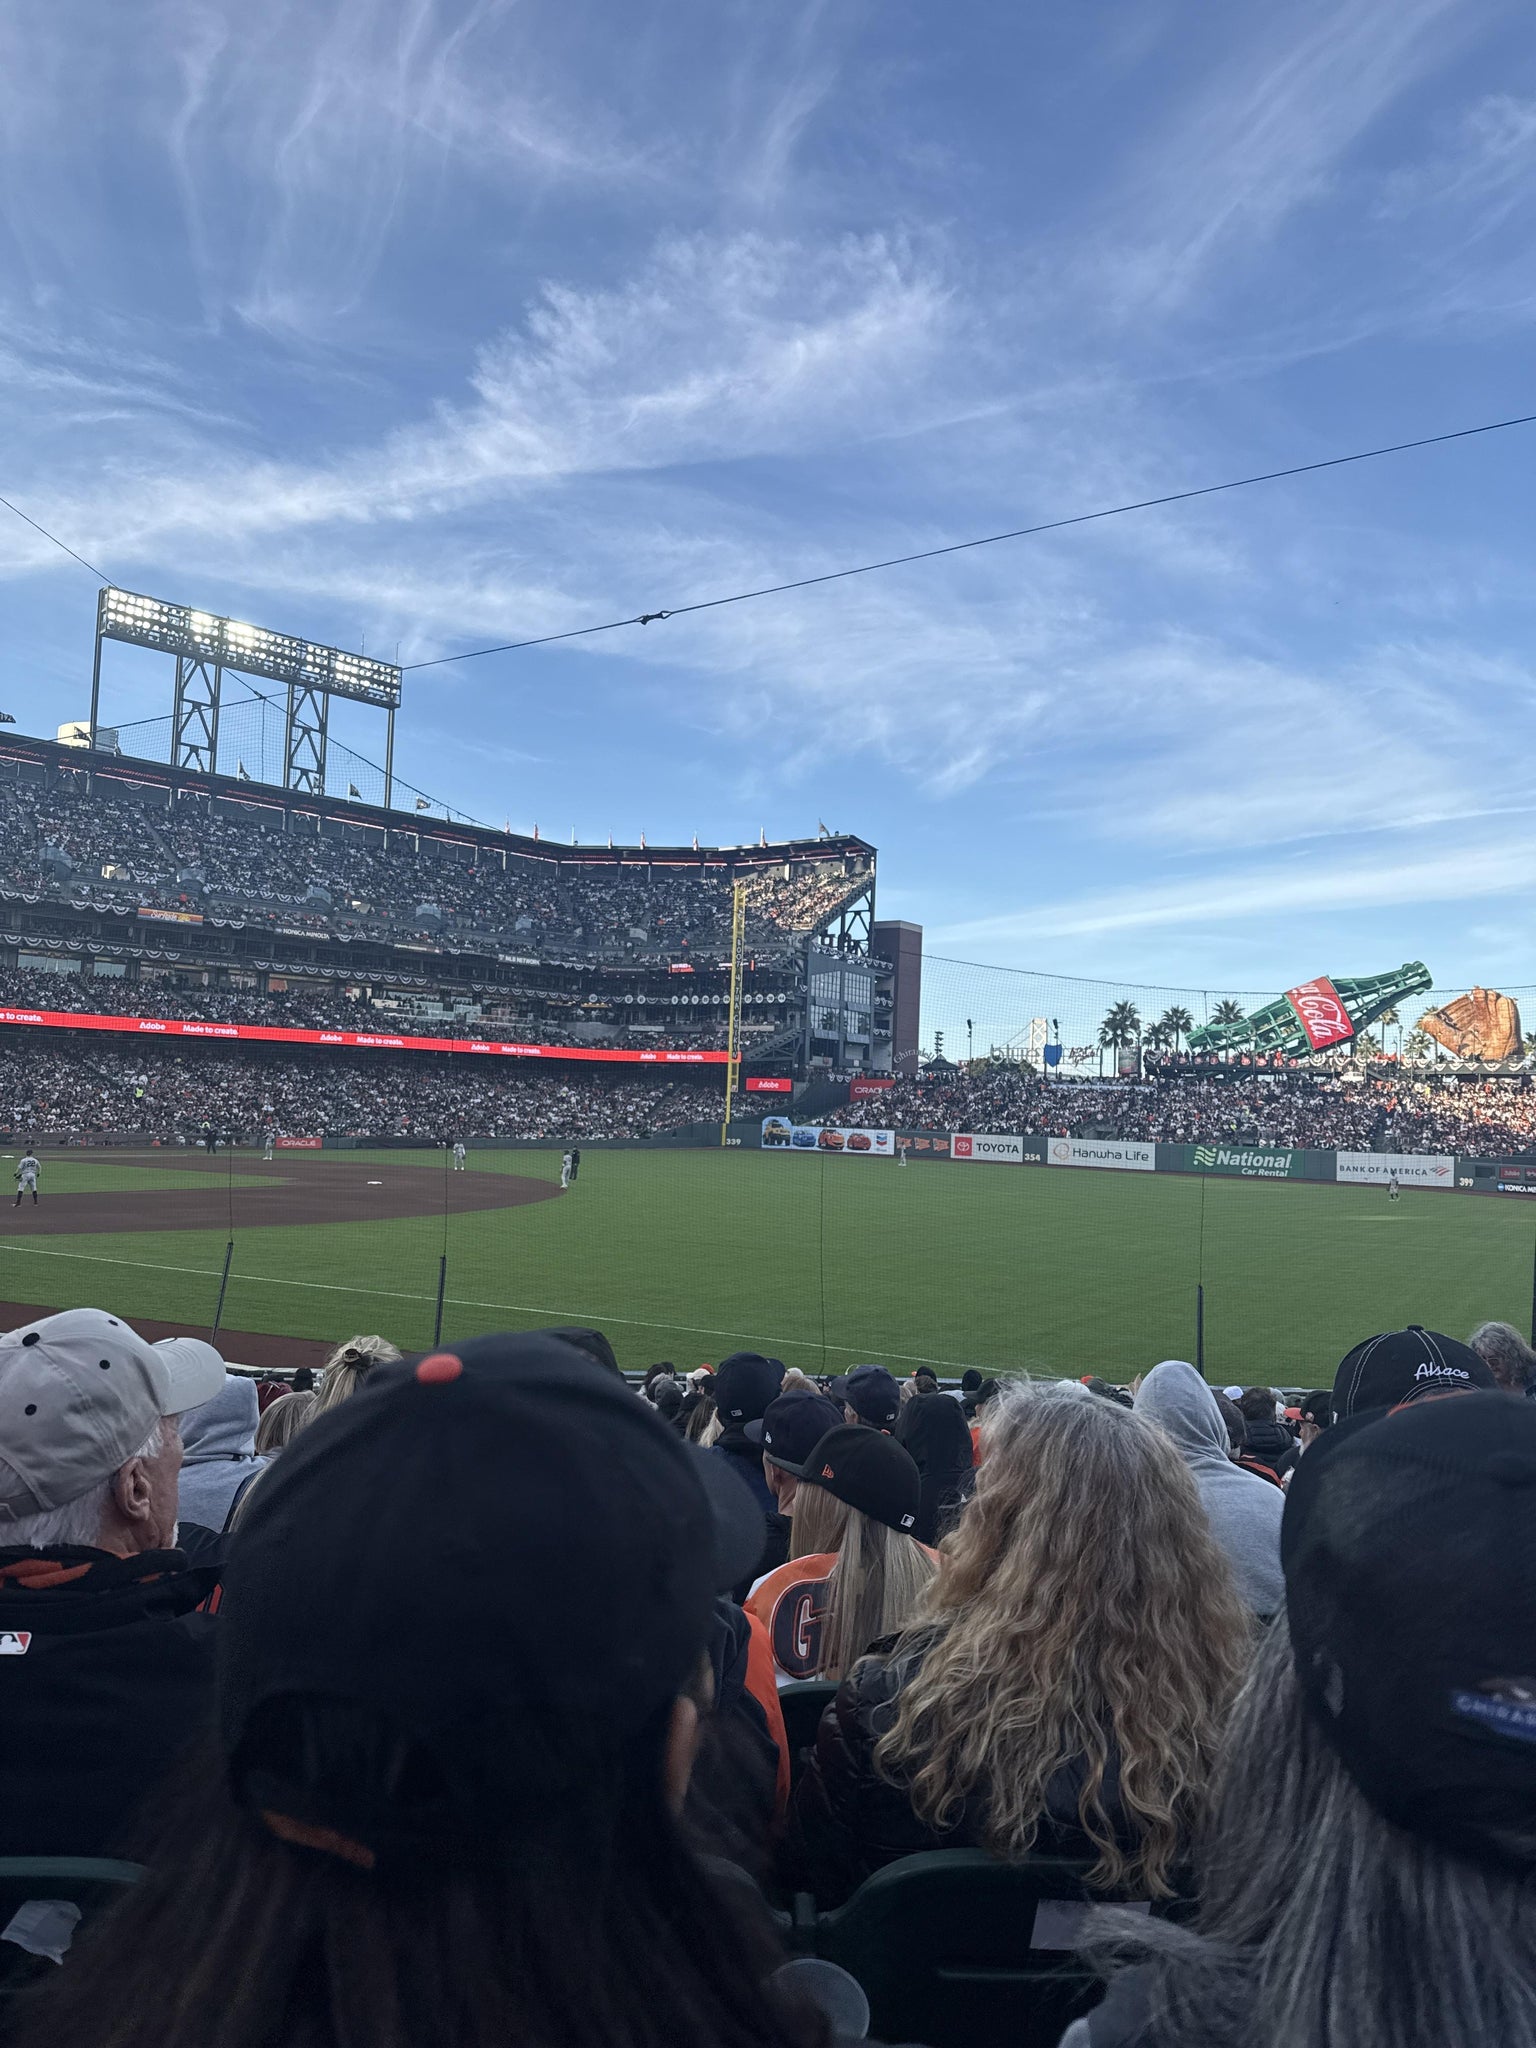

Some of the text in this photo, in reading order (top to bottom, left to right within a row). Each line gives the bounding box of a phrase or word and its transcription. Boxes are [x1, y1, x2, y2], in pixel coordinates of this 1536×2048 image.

[6, 1012, 15, 1020] to
[16, 1013, 44, 1022] create.
[1298, 995, 1349, 1039] Cola
[139, 1022, 166, 1030] Adobe
[183, 1025, 204, 1033] Made
[205, 1026, 213, 1034] to
[320, 1034, 343, 1042] Adobe
[356, 1036, 374, 1044] Made
[382, 1038, 404, 1046] create.
[523, 1047, 541, 1055] create.
[990, 1044, 1040, 1064] blue
[758, 1081, 779, 1089] Adobe
[976, 1142, 1019, 1154] TOYOTA
[1024, 1153, 1041, 1162] 354
[1072, 1148, 1149, 1162] Hanwha Life
[1216, 1150, 1292, 1168] National
[1258, 1168, 1288, 1177] Rental
[1339, 1165, 1428, 1176] BANK OF AMERICA
[1459, 1178, 1474, 1187] 399
[1504, 1184, 1527, 1193] KONICA
[1414, 1361, 1470, 1380] Alsace
